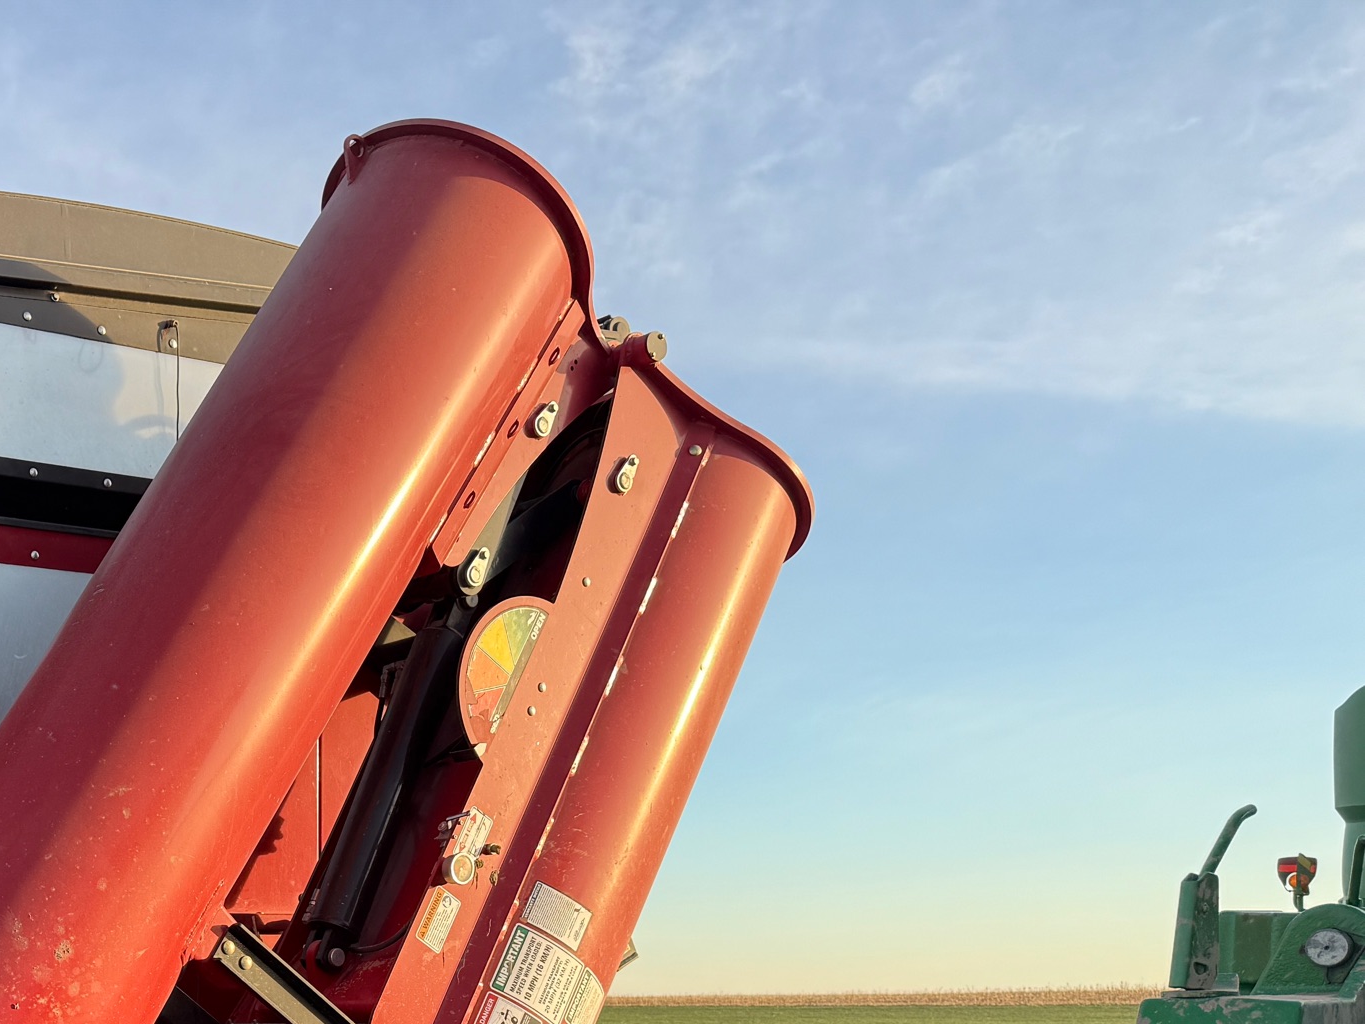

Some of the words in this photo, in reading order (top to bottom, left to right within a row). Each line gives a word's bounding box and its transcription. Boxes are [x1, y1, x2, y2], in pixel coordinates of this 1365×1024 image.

[530, 612, 546, 640] OPEN
[423, 892, 441, 928] WARNING
[495, 929, 527, 986] IMPORTANT
[509, 965, 524, 992] MAXIMUM
[520, 936, 537, 965] TRANSPORT
[515, 978, 527, 994] SPEED
[523, 962, 533, 978] WHEN
[529, 940, 543, 962] LOADED:
[539, 943, 553, 964] KM/H)
[527, 975, 539, 992] MPH
[534, 963, 545, 976] (16
[523, 991, 532, 1000] 10
[567, 973, 591, 1019] IMPORTANT
[479, 998, 494, 1024] DANGER
